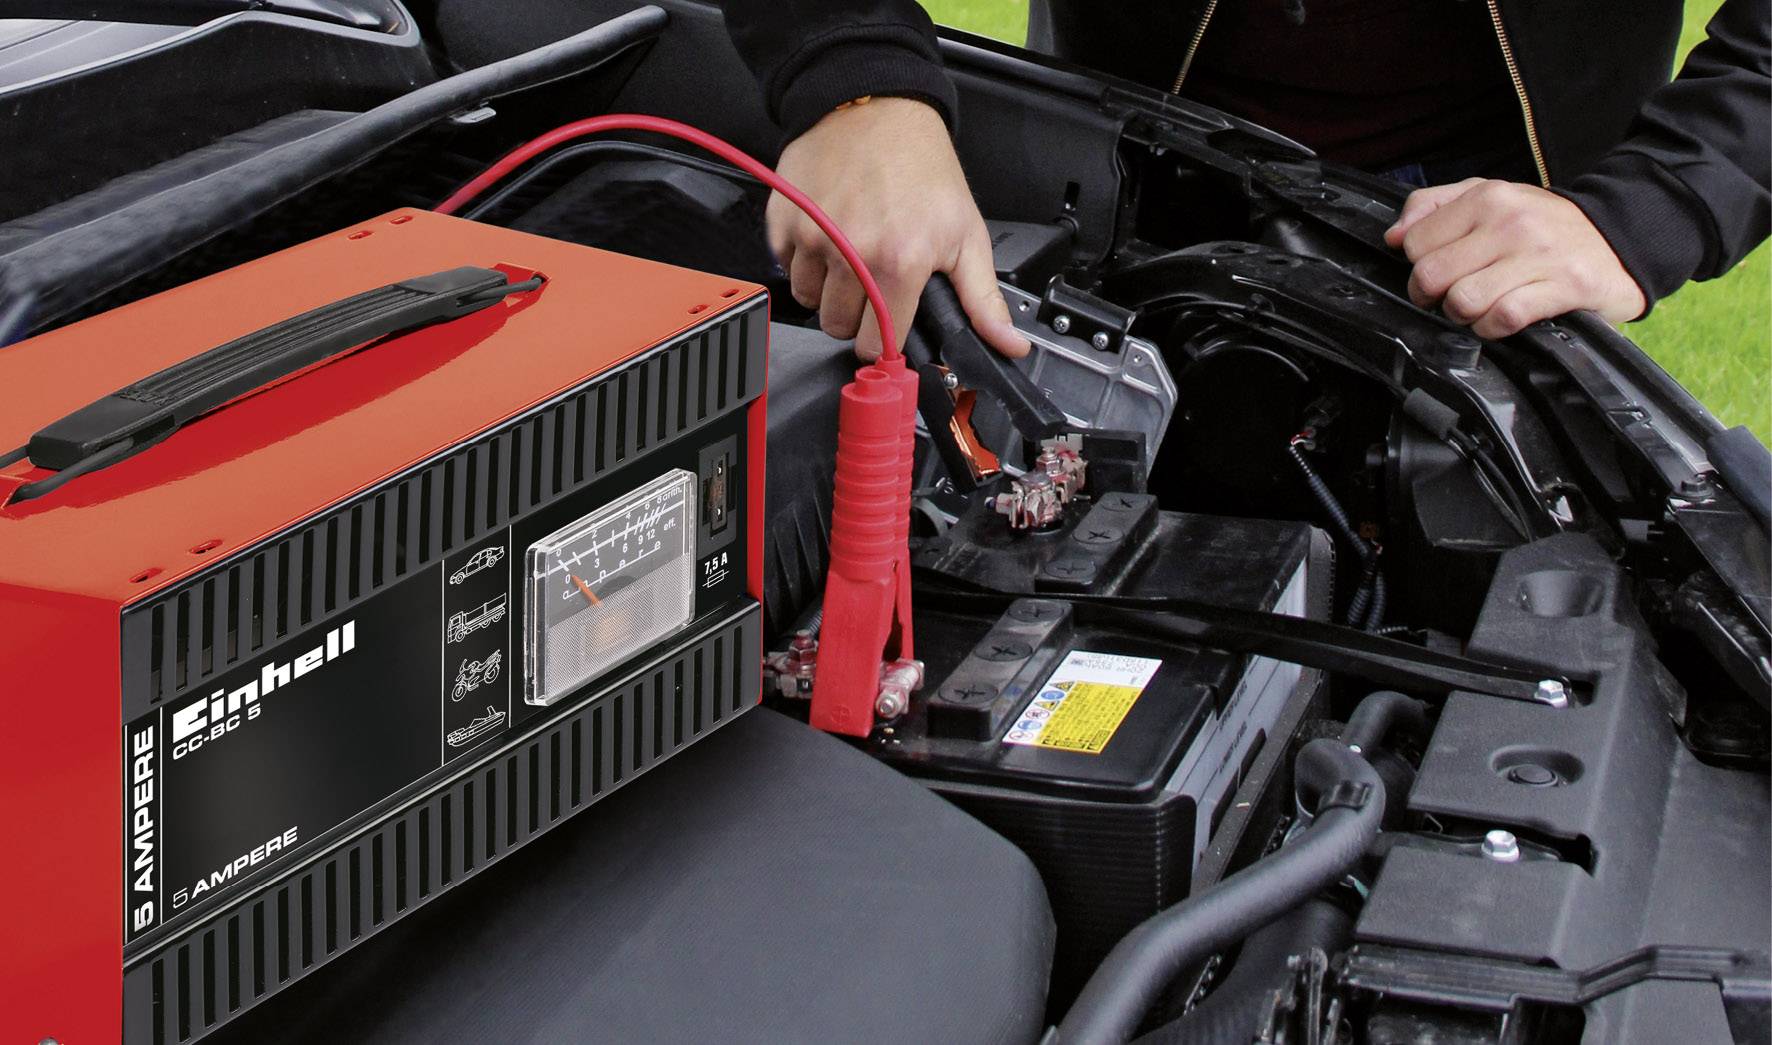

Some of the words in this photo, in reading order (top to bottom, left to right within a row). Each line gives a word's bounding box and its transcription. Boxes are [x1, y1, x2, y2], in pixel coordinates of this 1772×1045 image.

[565, 573, 571, 585] 0
[594, 557, 600, 569] 3
[622, 543, 629, 553] 6
[638, 534, 644, 545] 9
[646, 528, 656, 541] 12
[704, 558, 719, 575] 7,5
[720, 551, 728, 565] A
[172, 619, 356, 744] Einhell
[172, 713, 241, 761] CC-BC
[247, 702, 262, 721] 5
[134, 726, 154, 892] AMPERE
[172, 887, 189, 910] 5
[191, 826, 299, 900] AMPERE
[134, 900, 154, 932] 5
